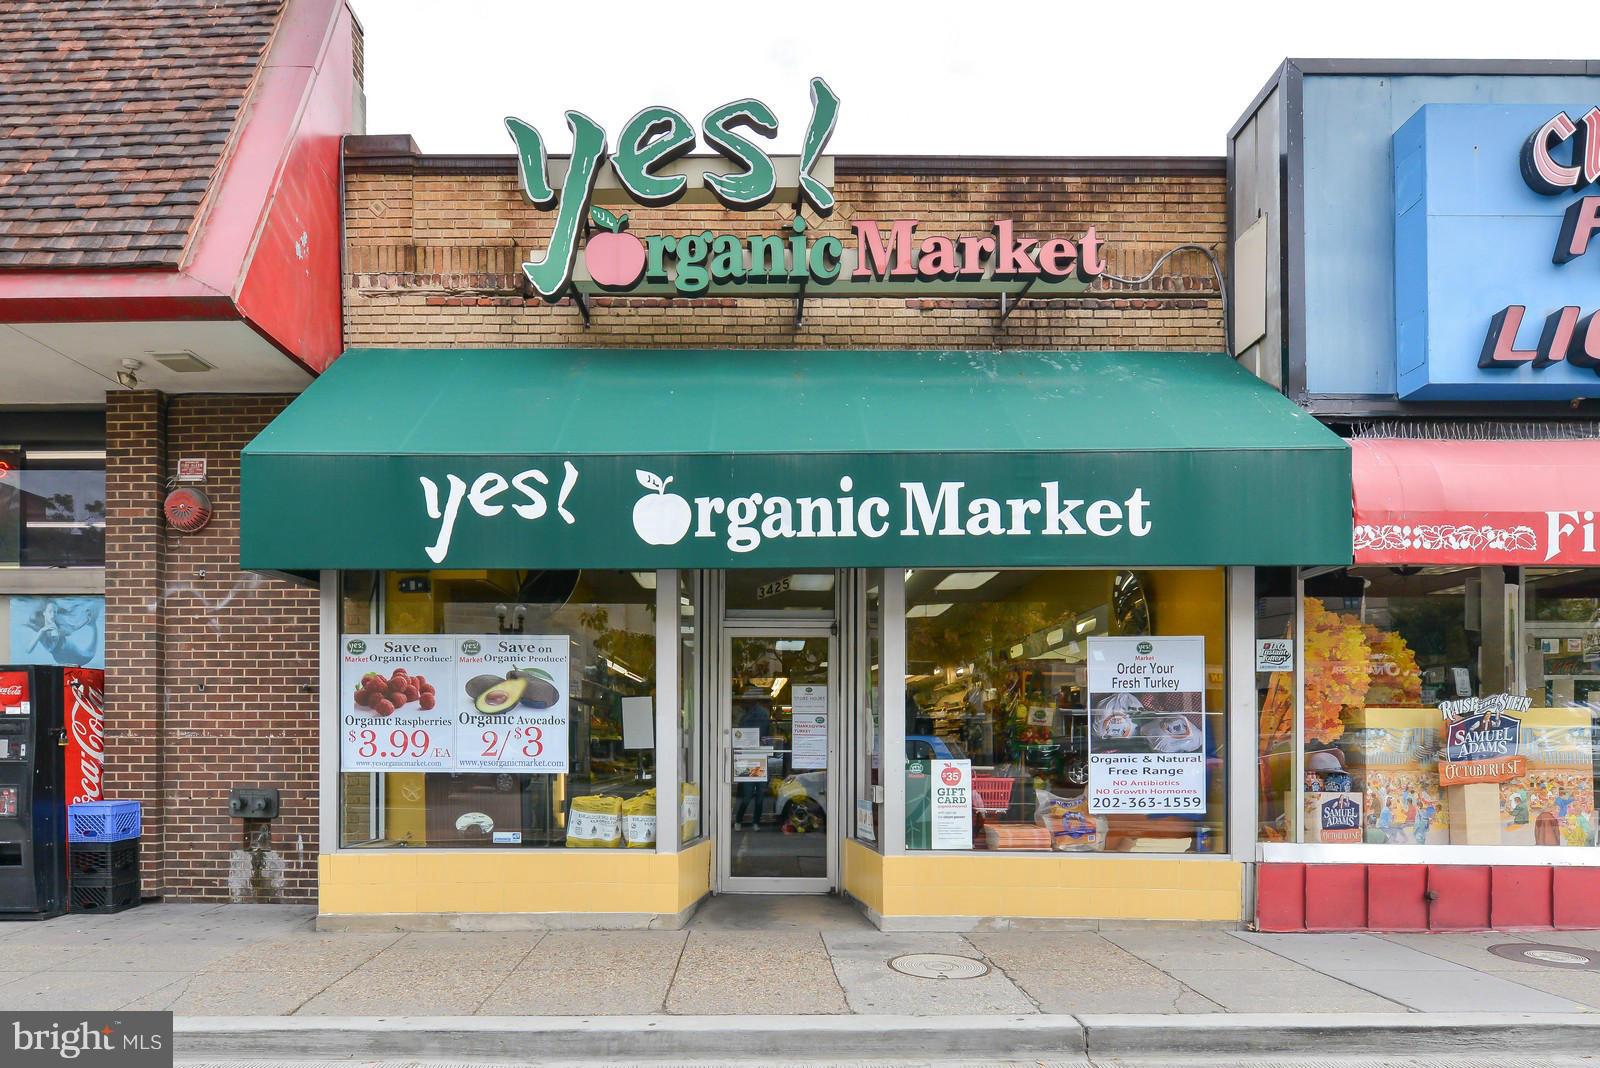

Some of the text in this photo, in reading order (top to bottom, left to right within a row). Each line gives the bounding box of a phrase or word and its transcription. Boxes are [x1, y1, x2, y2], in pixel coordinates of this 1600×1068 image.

[504, 76, 840, 295] yes!
[852, 219, 1106, 283] Market
[419, 460, 578, 564] yes!
[900, 480, 1152, 536] Market
[1544, 510, 1597, 562] Fi
[759, 579, 790, 598] 3425
[384, 641, 420, 653] Save
[498, 641, 536, 653] Save
[369, 654, 452, 664] Organic Produce!
[484, 653, 567, 664] Organic Produce!
[1117, 662, 1175, 675] Order Your
[1112, 677, 1180, 691] Fresh Turkey
[1438, 696, 1479, 720] RAISE
[1497, 692, 1533, 712] STEIN
[345, 714, 452, 728] Organic Raspberries
[459, 712, 566, 728] Organic Avocados
[1454, 727, 1514, 746] SAMUEL
[1458, 741, 1508, 758] ADAMS
[356, 759, 442, 768] www.yesorganicmarket.com
[459, 758, 564, 768] www.yesorganicmarket.com
[1091, 755, 1202, 765] Organic & Natural
[1109, 767, 1184, 777] Free Range
[937, 787, 966, 796] GIFT
[937, 796, 967, 804] CARD
[1093, 797, 1201, 808] 202-363-1559
[1323, 806, 1358, 819] SAMUEL
[1326, 816, 1355, 827] ADAMS
